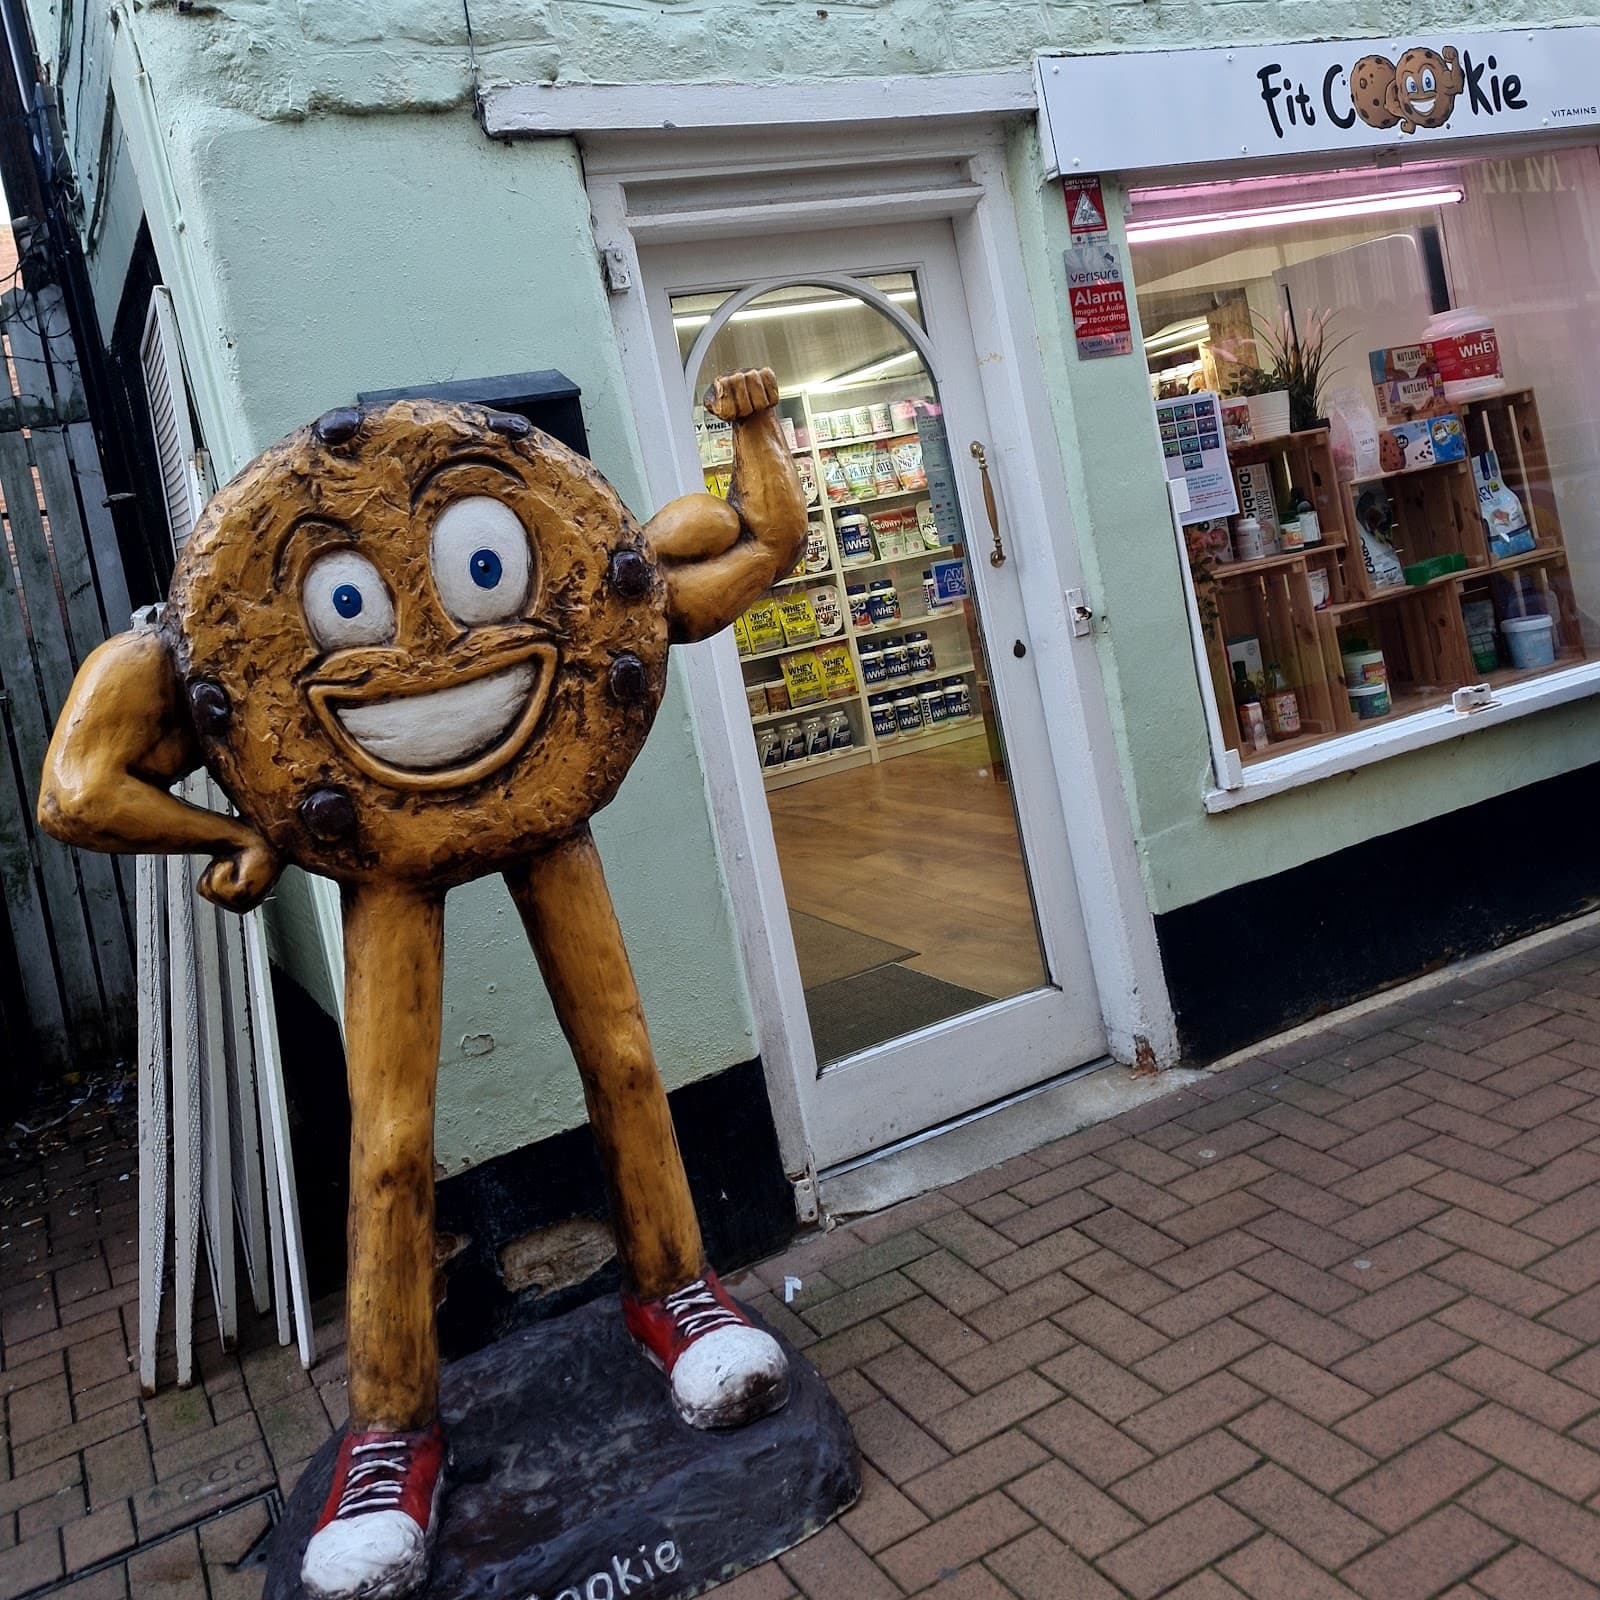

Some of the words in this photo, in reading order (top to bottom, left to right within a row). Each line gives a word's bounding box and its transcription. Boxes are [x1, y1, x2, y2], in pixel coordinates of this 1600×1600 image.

[1256, 63, 1316, 138] Fit
[1551, 106, 1597, 118] VITAMINS
[1070, 268, 1119, 283] verisure
[1074, 289, 1123, 307] Alarm
[1075, 309, 1098, 317] Images
[1106, 303, 1125, 312] Audio
[1089, 312, 1126, 325] recording
[1396, 349, 1420, 362] NUTLOVE
[1458, 340, 1495, 359] WHEY
[1402, 380, 1428, 394] NUTLOVE
[808, 540, 824, 548] HEY
[846, 538, 870, 551] WHE
[807, 546, 827, 555] OTEIN
[781, 602, 806, 614] WHEY
[815, 604, 837, 613] WHEY
[875, 605, 897, 617] WHEY
[749, 608, 774, 622] WHEY
[785, 614, 811, 624] COMPLEX
[815, 610, 841, 620] ROTEIN
[751, 622, 777, 632] COMPLEX
[788, 662, 813, 675] WHEY
[823, 656, 846, 669] WHEY
[910, 657, 931, 669] WHEY
[790, 674, 818, 686] COMPLEX
[825, 669, 850, 679] COMPLEX
[949, 702, 971, 714] WHEY
